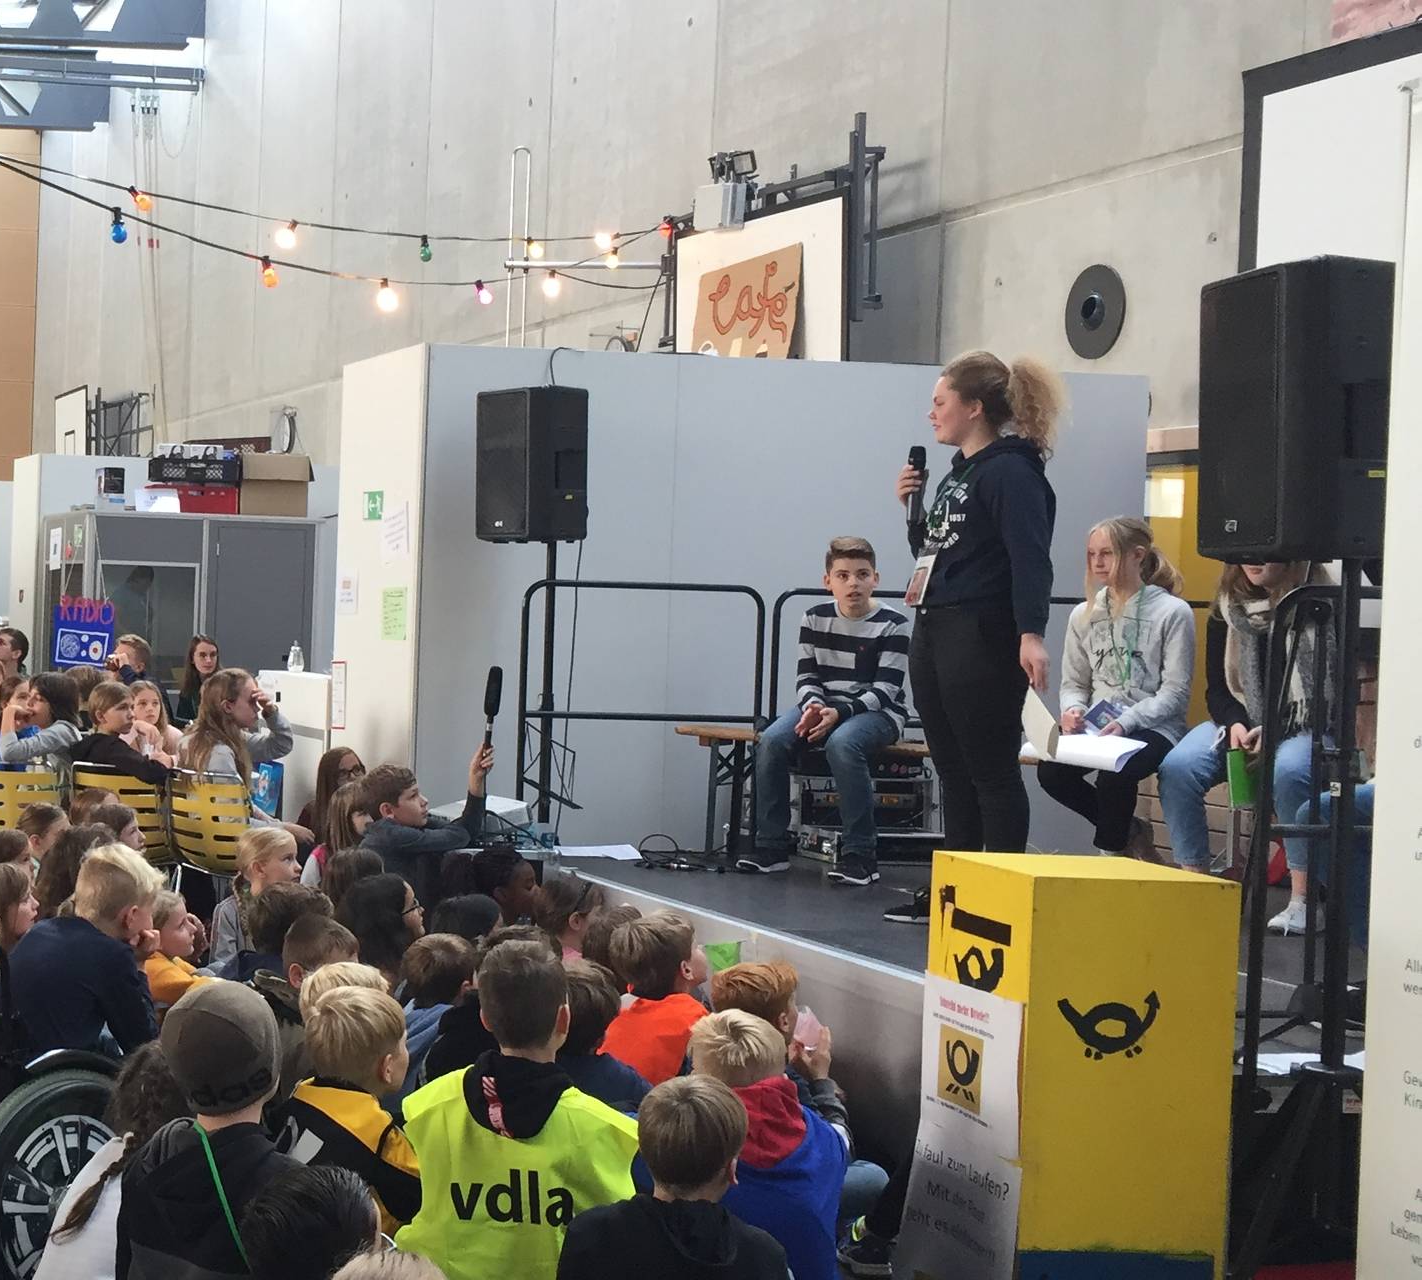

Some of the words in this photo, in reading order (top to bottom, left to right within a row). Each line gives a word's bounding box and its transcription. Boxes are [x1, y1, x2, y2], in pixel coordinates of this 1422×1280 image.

[709, 261, 796, 344] Café
[59, 595, 115, 625] RADIO
[450, 1168, 574, 1227] vdla
[922, 1143, 944, 1166] faul
[947, 1156, 968, 1178] zum
[969, 1163, 1010, 1201] Laufen?
[1390, 1221, 1420, 1245] Leben
